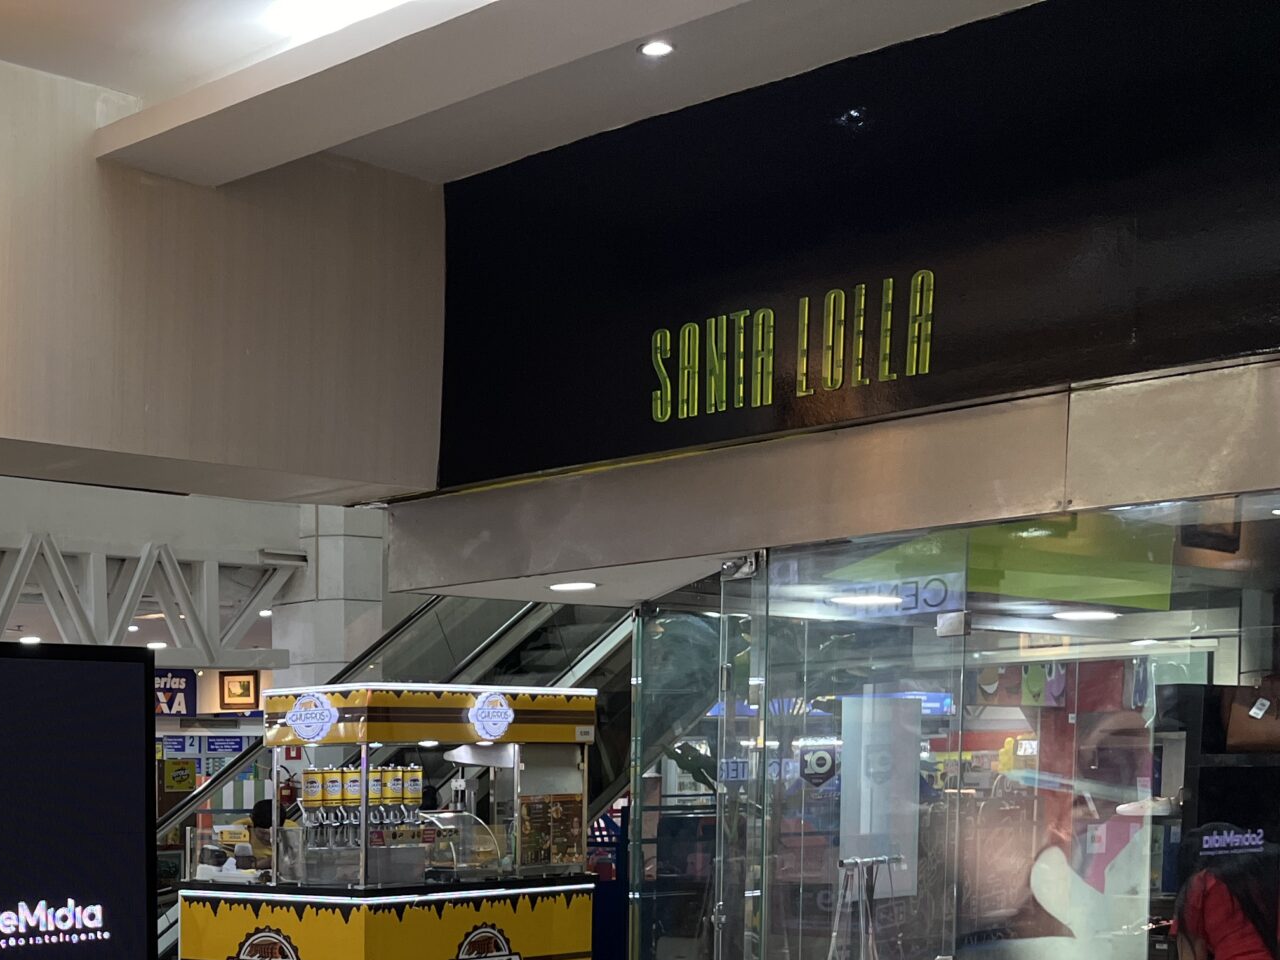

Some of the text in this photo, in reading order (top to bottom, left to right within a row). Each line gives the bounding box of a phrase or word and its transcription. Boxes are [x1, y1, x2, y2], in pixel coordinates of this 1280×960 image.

[651, 269, 934, 423] SANTA LOLLA
[290, 711, 326, 722] CHURROS
[480, 710, 509, 720] CHURROS
